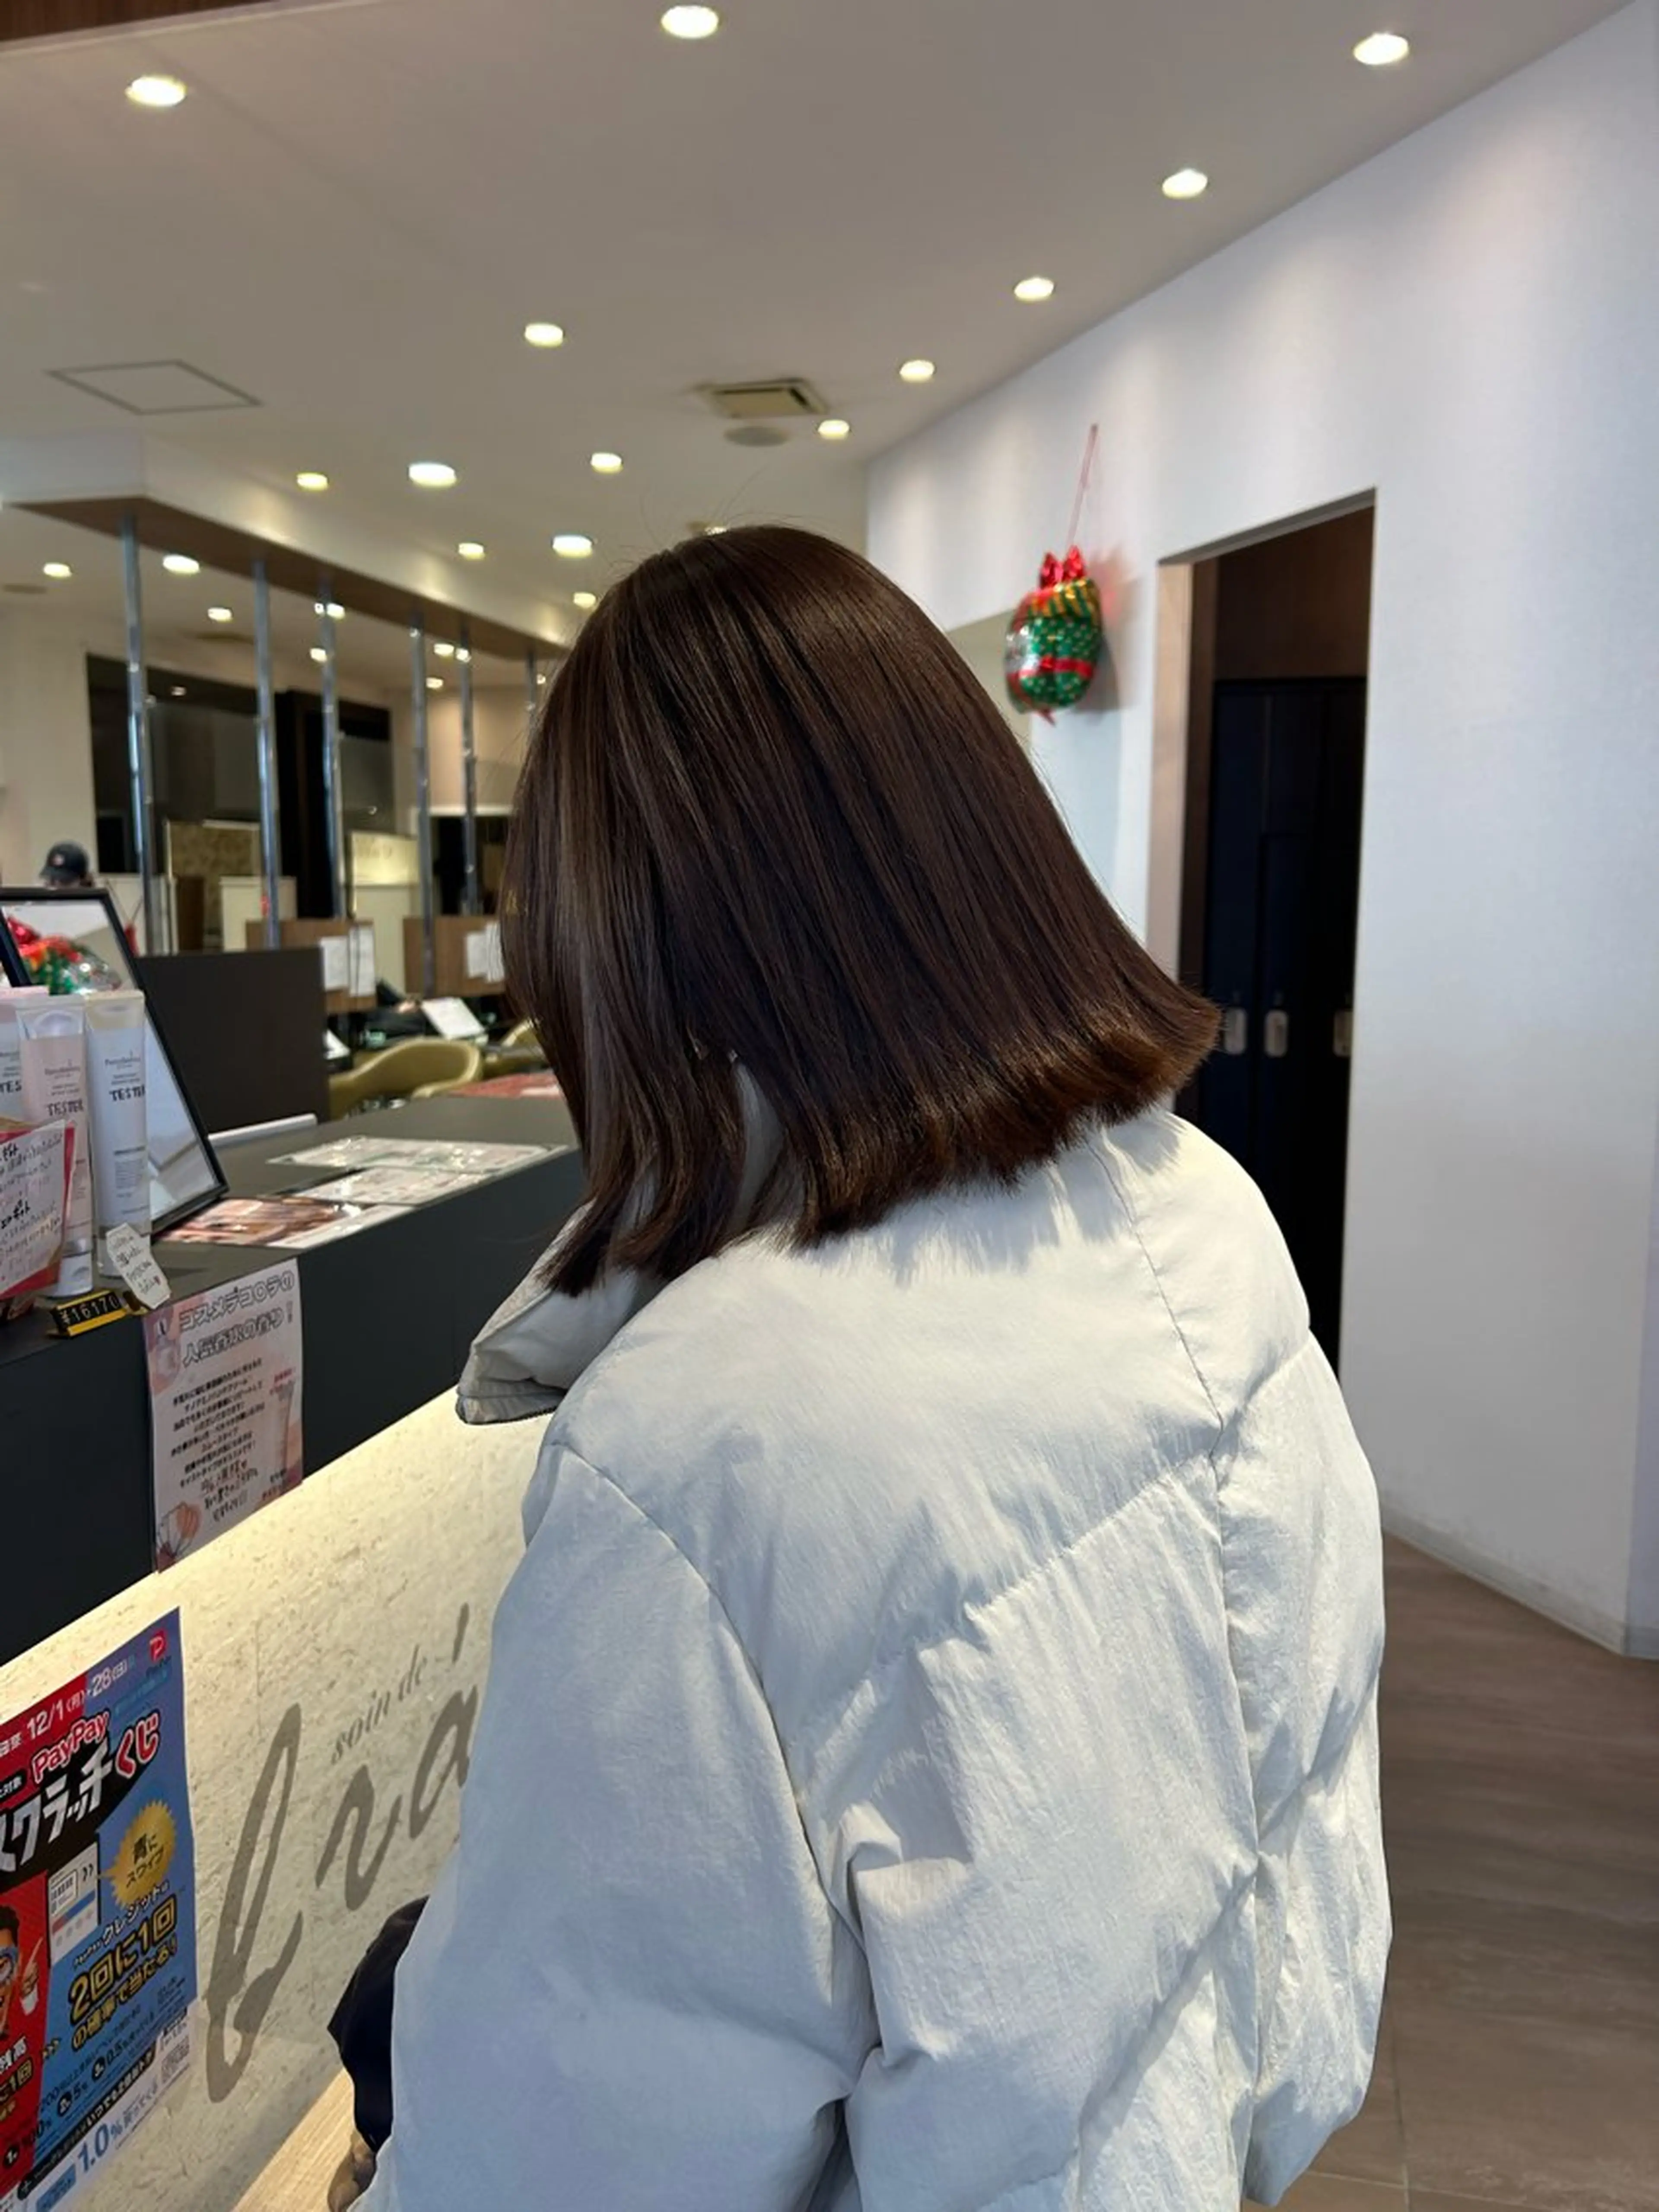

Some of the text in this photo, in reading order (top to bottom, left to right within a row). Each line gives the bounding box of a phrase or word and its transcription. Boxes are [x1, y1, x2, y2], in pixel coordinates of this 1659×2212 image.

[32, 1711, 109, 1784] PayPay
[331, 1643, 428, 1765] soin de
[69, 1894, 177, 2026] 2回に1回
